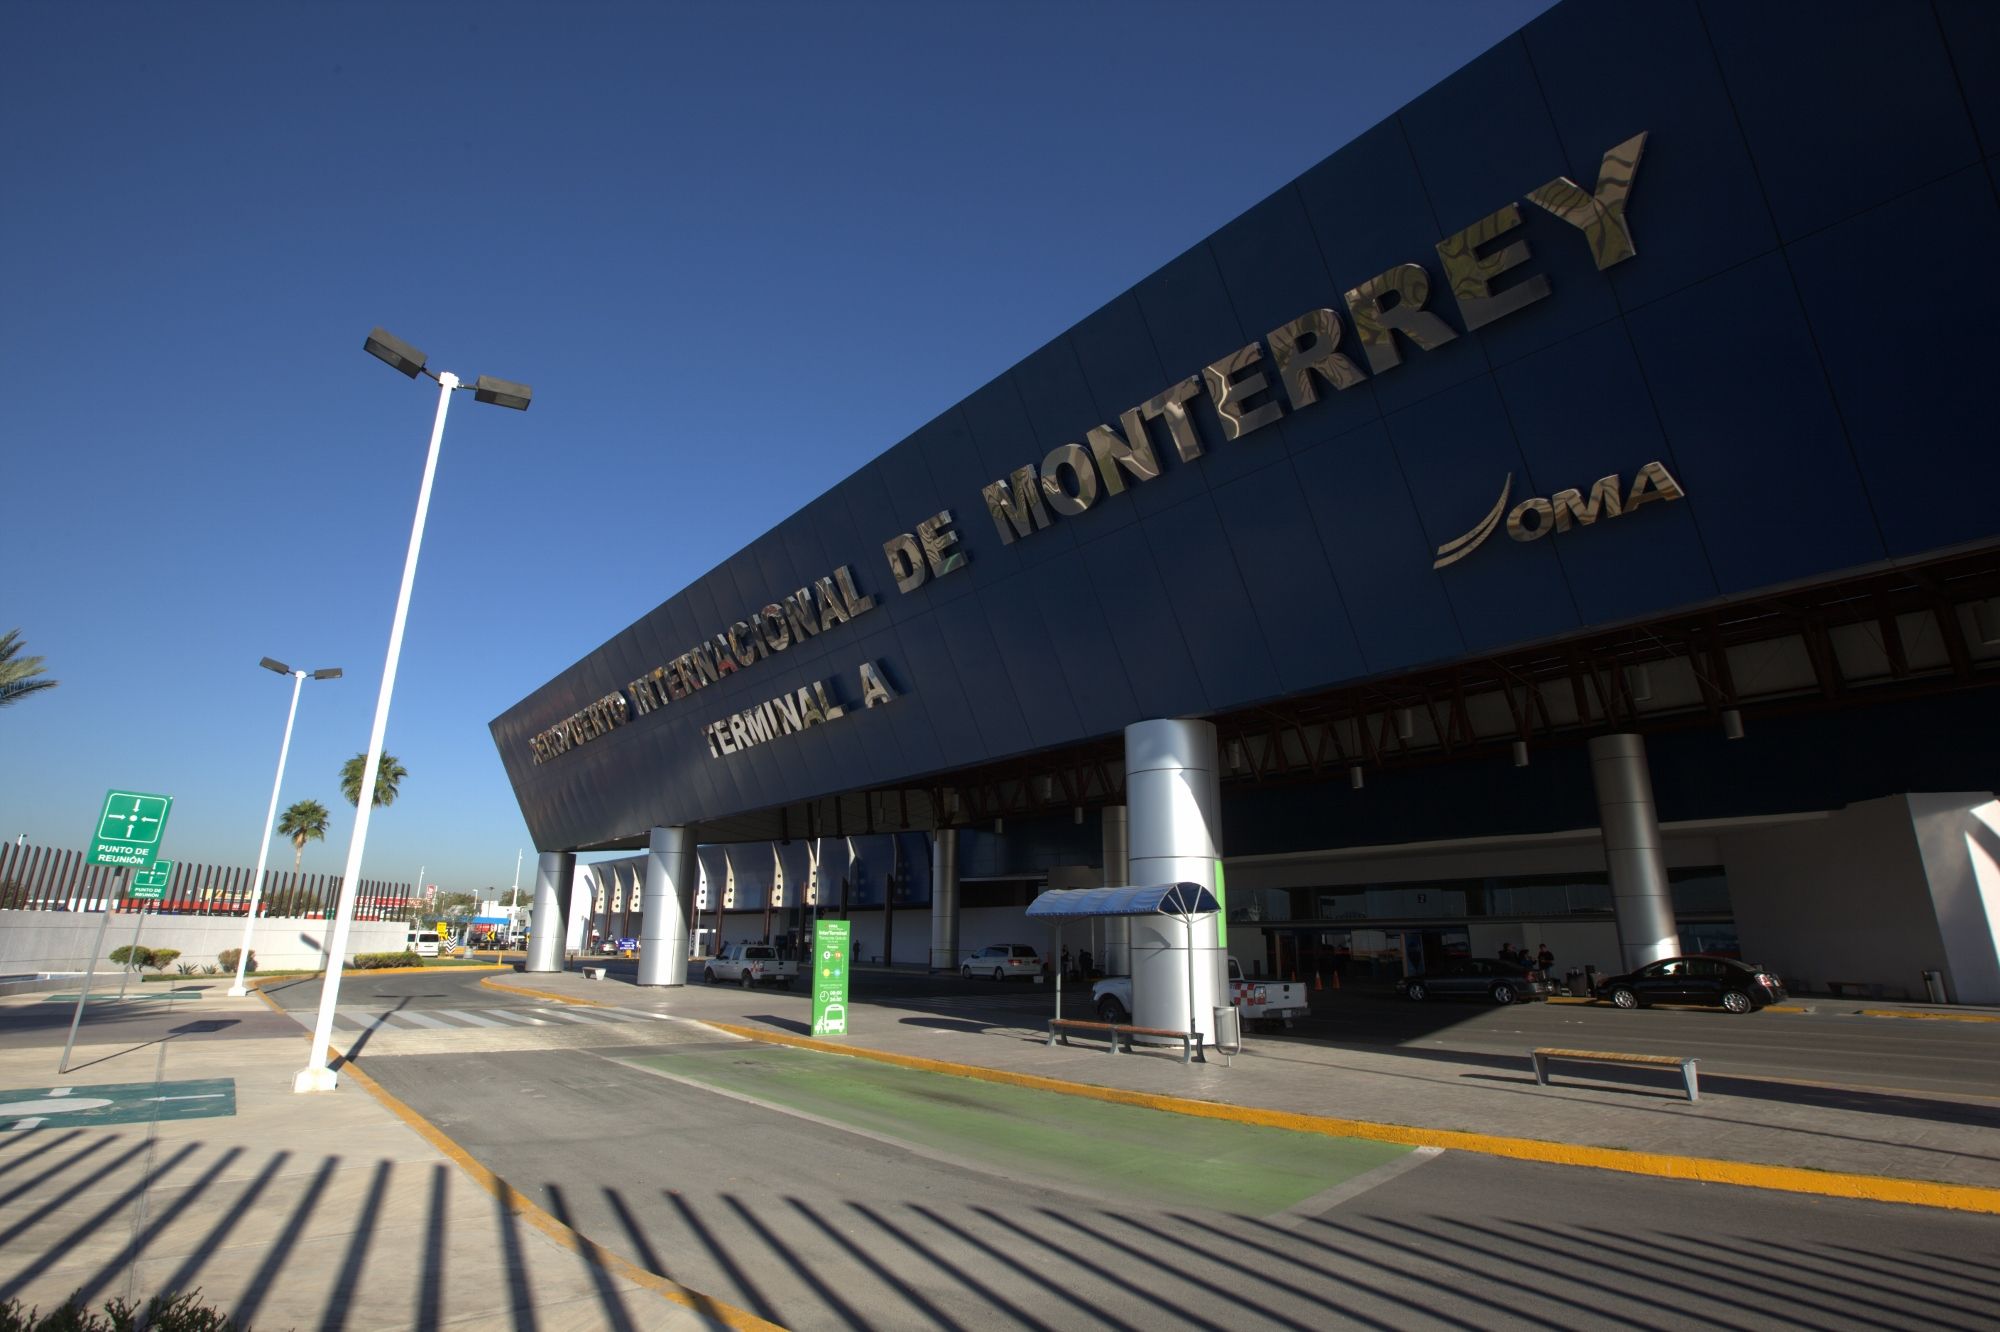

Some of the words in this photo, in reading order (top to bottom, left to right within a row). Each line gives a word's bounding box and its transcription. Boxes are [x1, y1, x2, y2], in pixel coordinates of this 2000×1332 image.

[528, 691, 630, 766] AEROPUERTO
[628, 565, 876, 716] INTERNACIONAL
[883, 510, 969, 594] DE
[981, 131, 1648, 545] MONTERREY
[1506, 461, 1685, 542] OMA
[702, 680, 846, 758] TERMINAL
[859, 662, 893, 709] A
[98, 845, 133, 854] PUNTO
[98, 854, 144, 864] REUNIÓN
